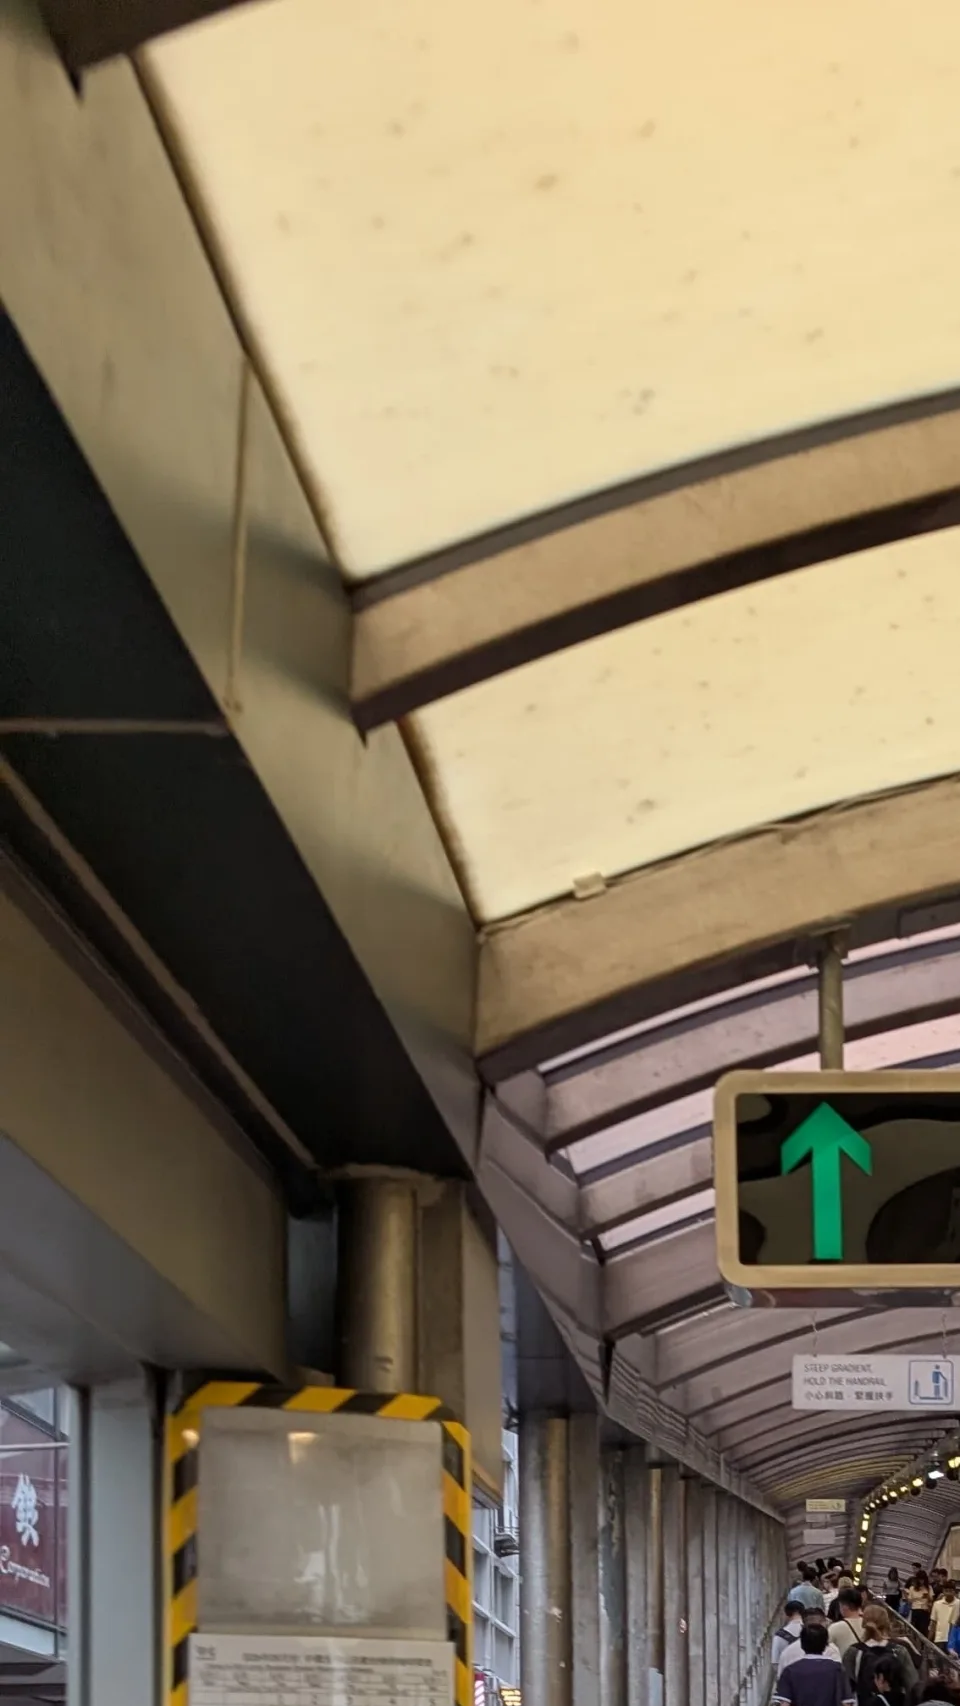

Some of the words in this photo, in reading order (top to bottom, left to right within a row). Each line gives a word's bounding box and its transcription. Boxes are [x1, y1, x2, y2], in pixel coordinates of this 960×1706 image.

[803, 1363, 829, 1373] STEEP
[803, 1377, 827, 1386] HOLD
[828, 1377, 844, 1386] THE
[845, 1377, 887, 1387] HANDRAIL
